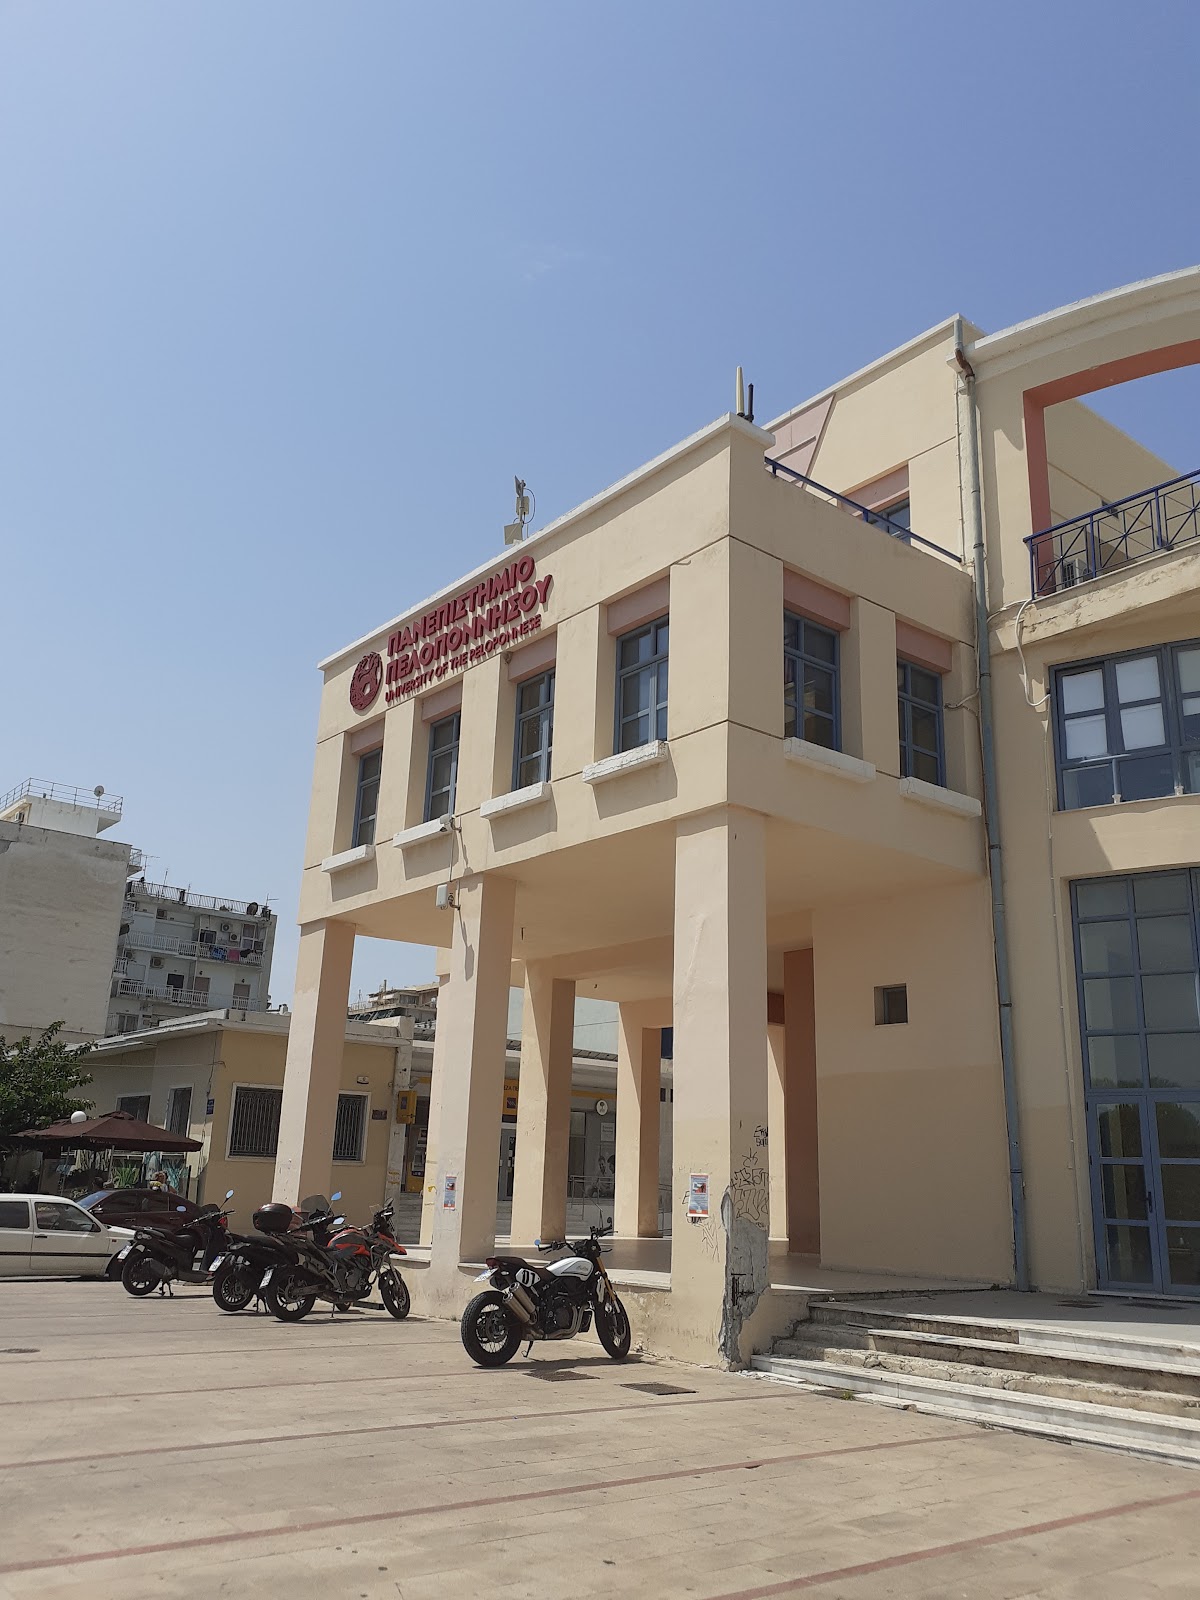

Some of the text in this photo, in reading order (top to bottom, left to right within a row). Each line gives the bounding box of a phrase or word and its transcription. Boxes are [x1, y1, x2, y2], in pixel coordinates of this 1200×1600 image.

[385, 574, 553, 685] ΠΕΛΟΠΟΝΝΗΣΟΥ
[387, 555, 535, 657] ΠΑΝΕΠΙΣΤΗΜΙΟ
[385, 613, 542, 703] UNIVERSITY OF THE PELOPONNESE
